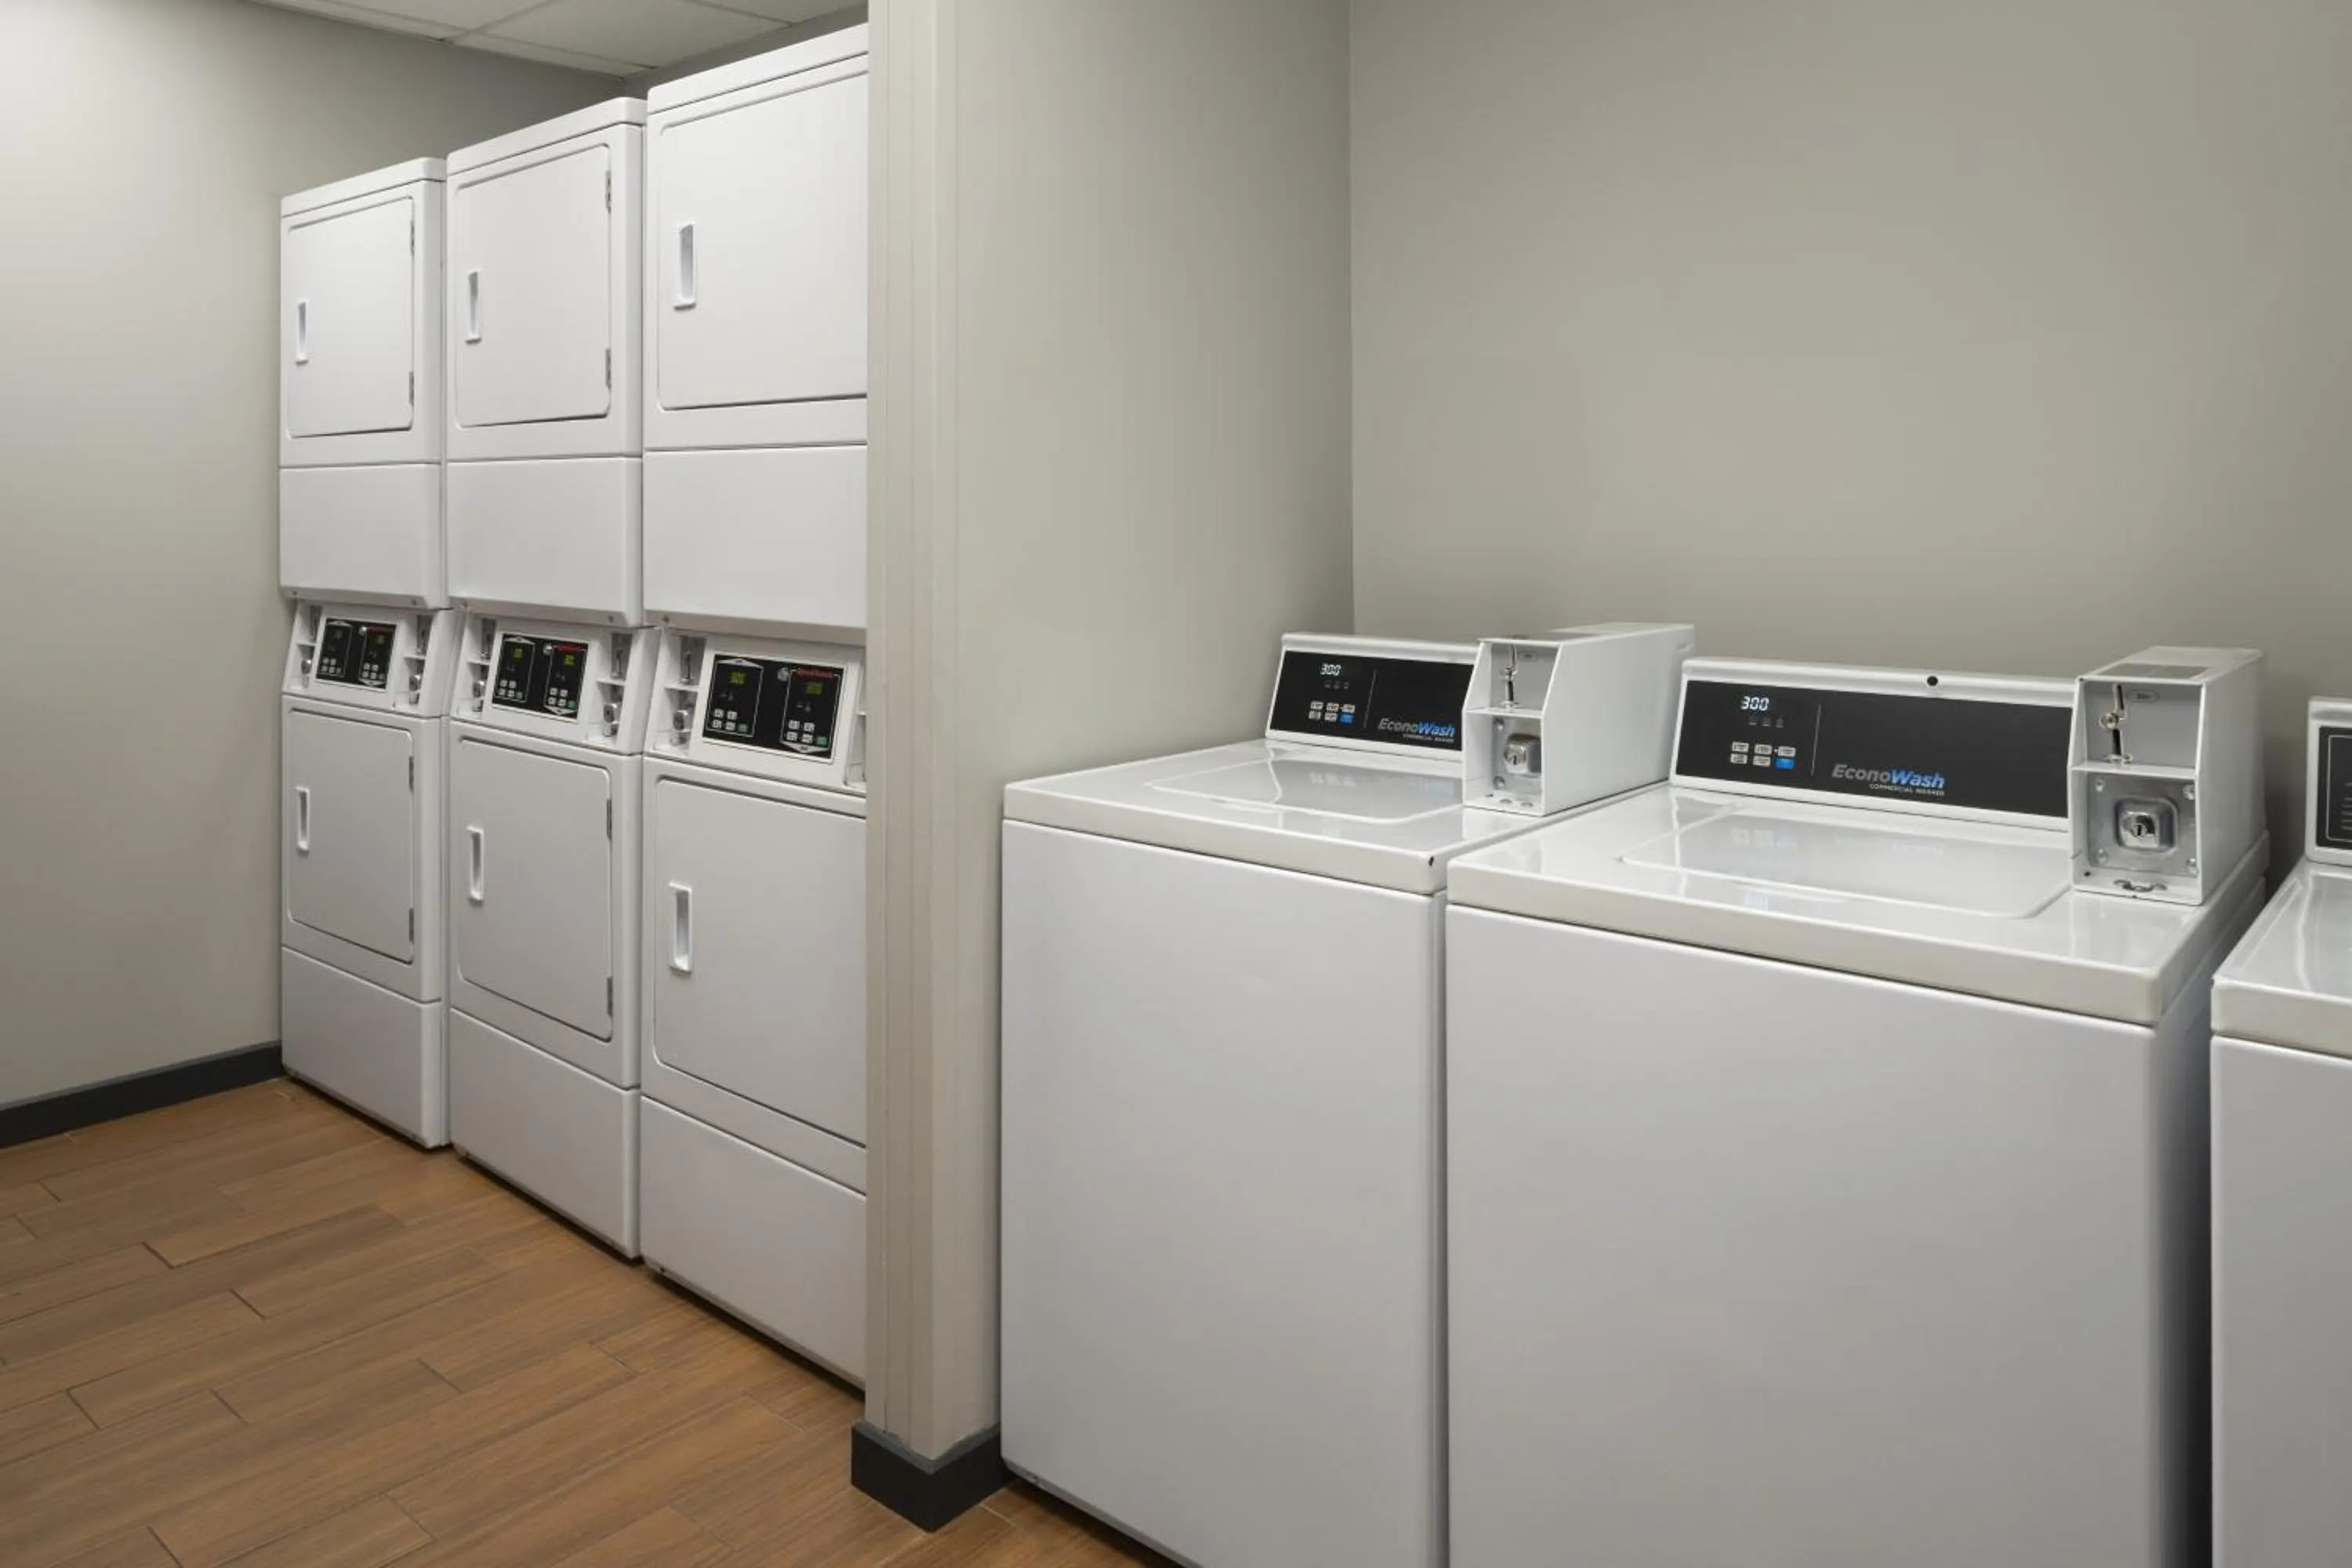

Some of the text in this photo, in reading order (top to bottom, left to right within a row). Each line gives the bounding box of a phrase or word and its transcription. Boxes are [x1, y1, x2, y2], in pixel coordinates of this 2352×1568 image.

[1320, 663, 1341, 676] 300
[1740, 695, 1769, 711] 300
[1378, 718, 1455, 737] EconoWash
[1831, 763, 1945, 789] EconoWash
